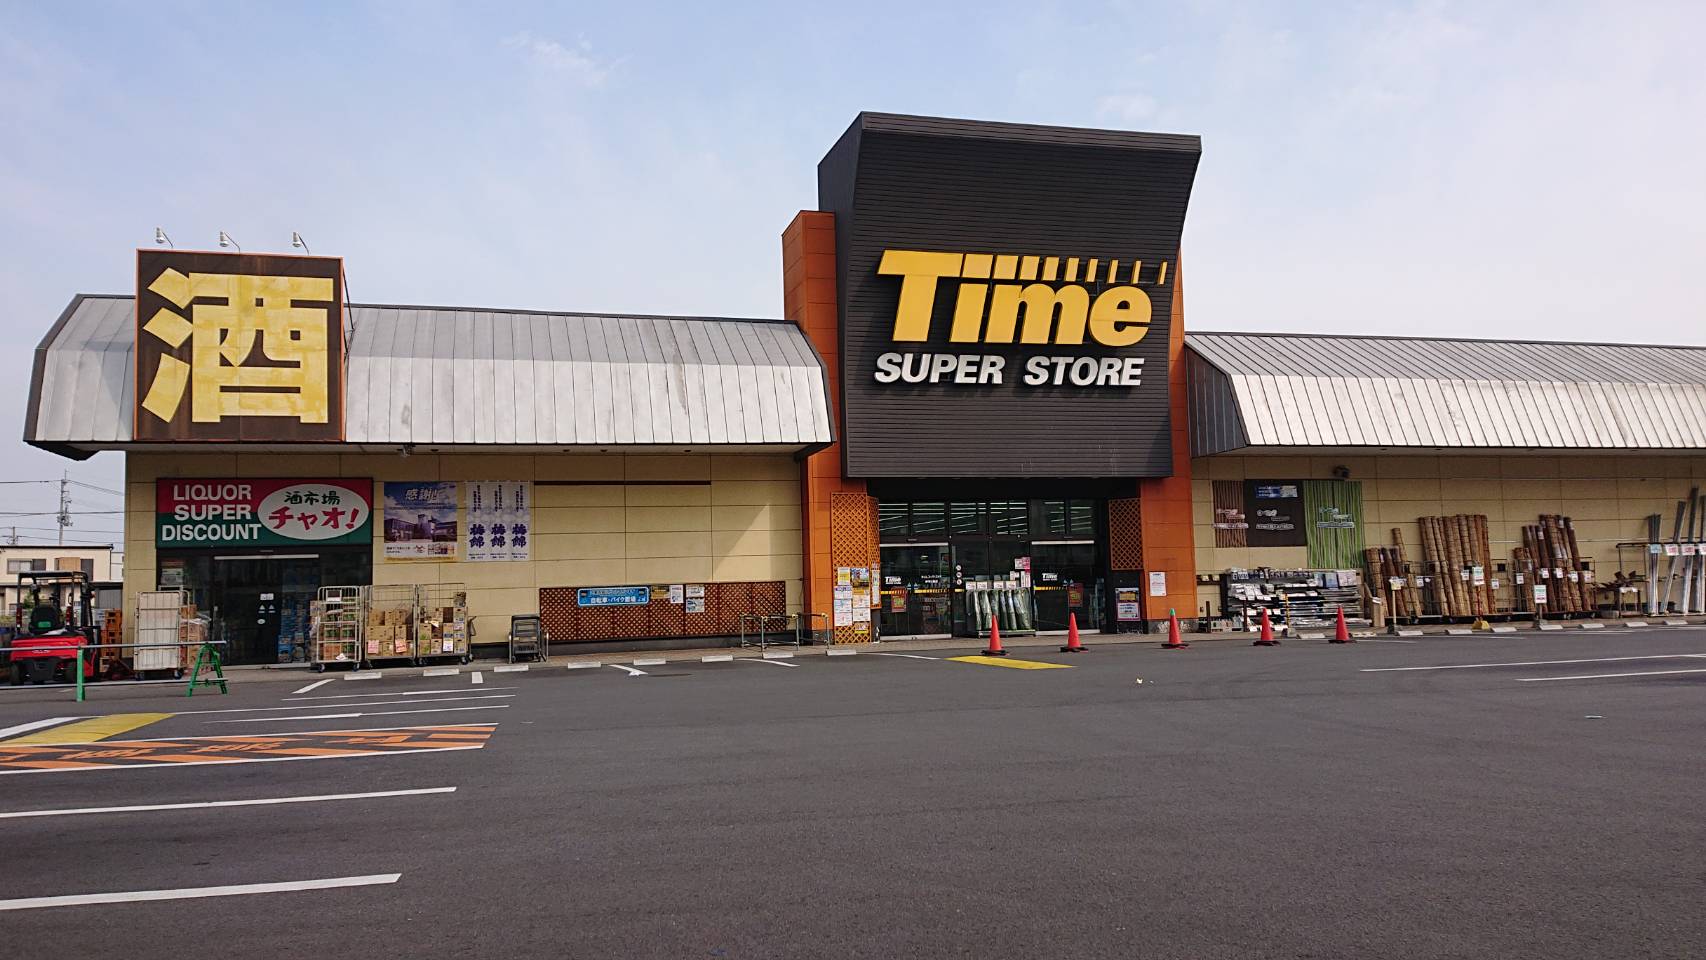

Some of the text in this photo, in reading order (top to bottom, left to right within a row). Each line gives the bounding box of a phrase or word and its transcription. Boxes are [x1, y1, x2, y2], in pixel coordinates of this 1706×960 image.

[877, 249, 1166, 347] Time
[141, 267, 334, 423] 酒
[874, 352, 1145, 386] SUPER STORE
[173, 484, 252, 501] LIQUOR
[284, 490, 341, 506] 酒市場
[174, 504, 251, 521] SUPER
[268, 506, 360, 530] チャオ!
[161, 524, 262, 541] DISCOUNT
